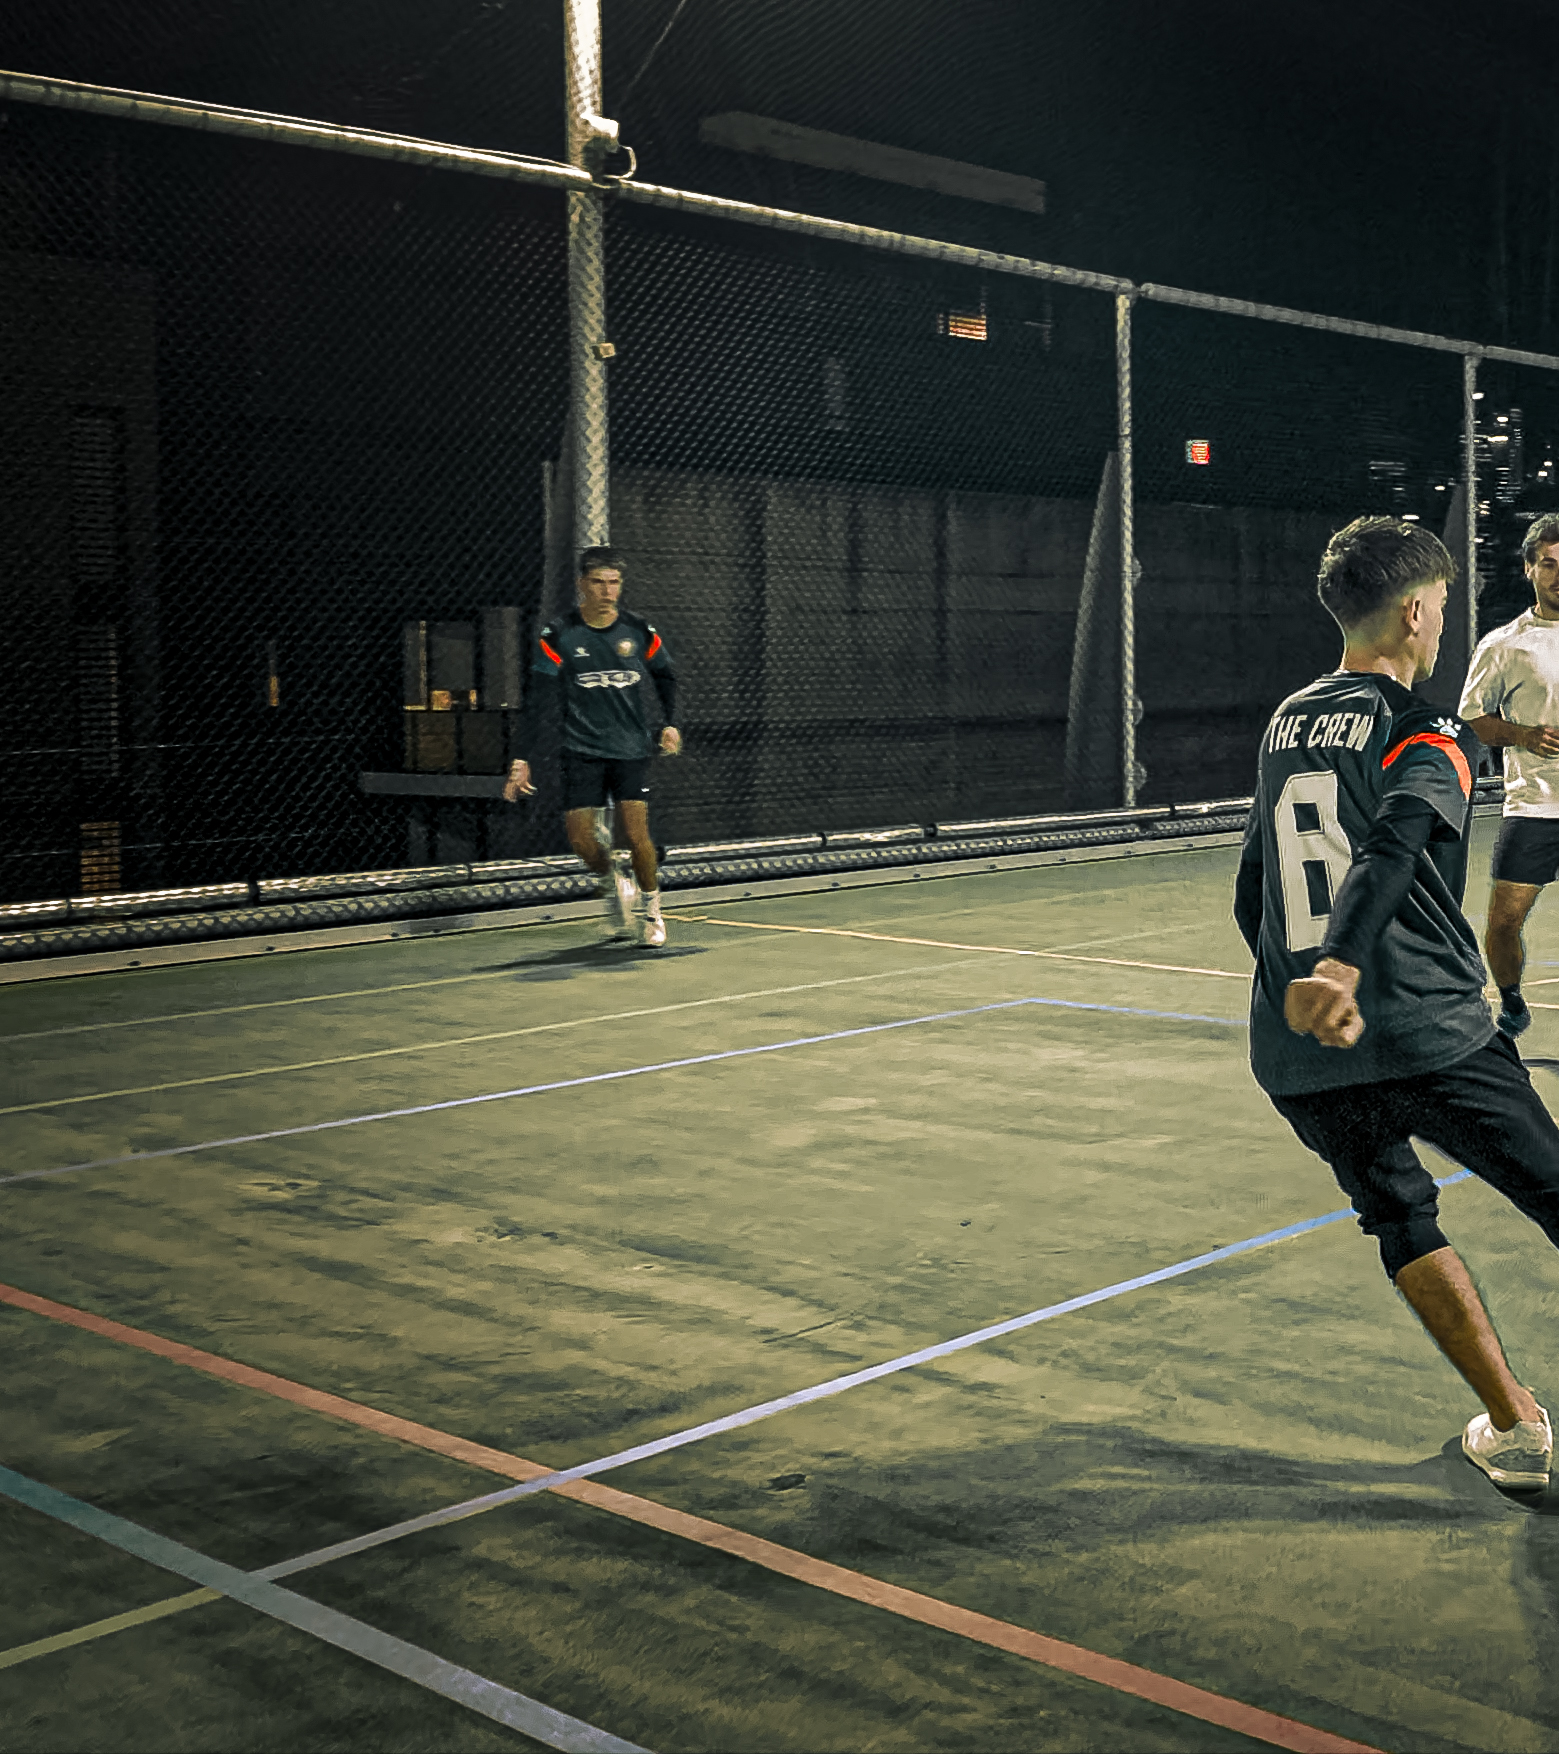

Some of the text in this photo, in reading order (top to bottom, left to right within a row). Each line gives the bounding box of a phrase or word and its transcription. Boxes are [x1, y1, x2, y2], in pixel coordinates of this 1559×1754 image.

[1268, 712, 1374, 754] THE CREW
[1275, 769, 1352, 953] 8
